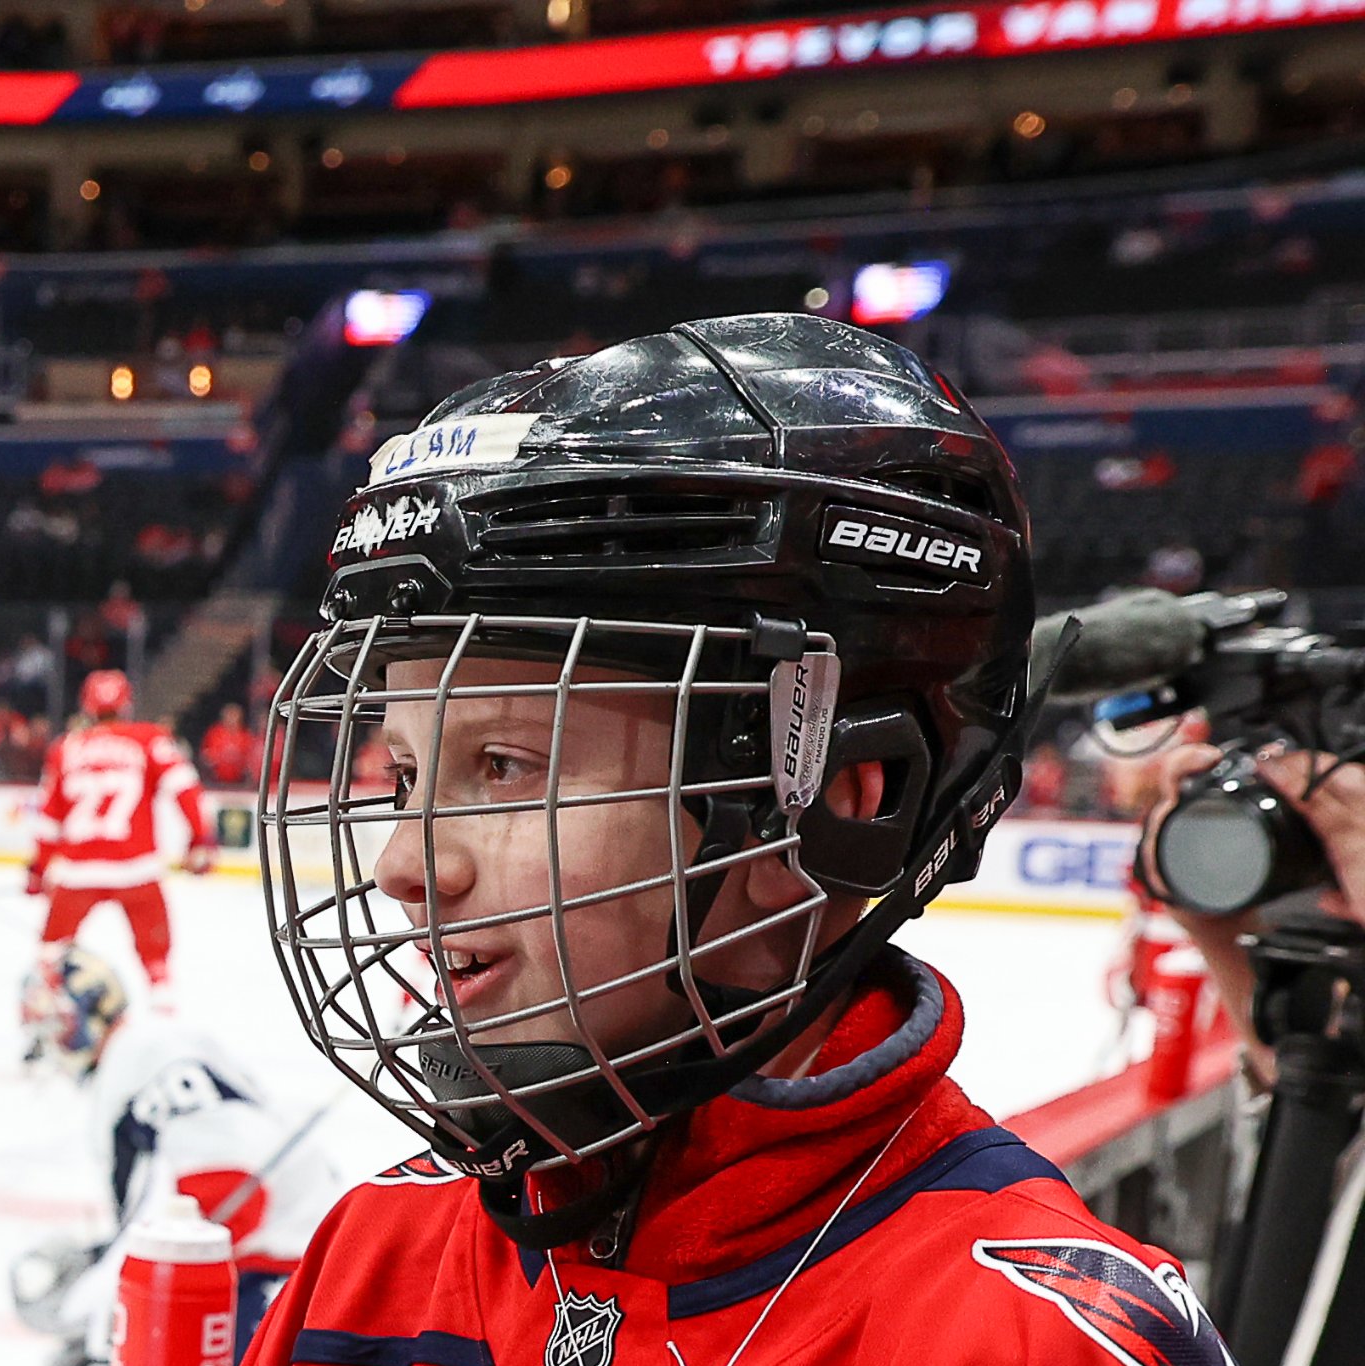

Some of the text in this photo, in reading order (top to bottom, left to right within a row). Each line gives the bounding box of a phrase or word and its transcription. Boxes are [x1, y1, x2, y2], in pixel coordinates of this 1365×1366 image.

[704, 12, 977, 74] TREVOR
[1001, 0, 1159, 45] VAN
[385, 426, 478, 475] LIAM
[829, 520, 982, 574] BAUER
[784, 663, 810, 779] BAUER
[556, 1320, 605, 1366] NHL
